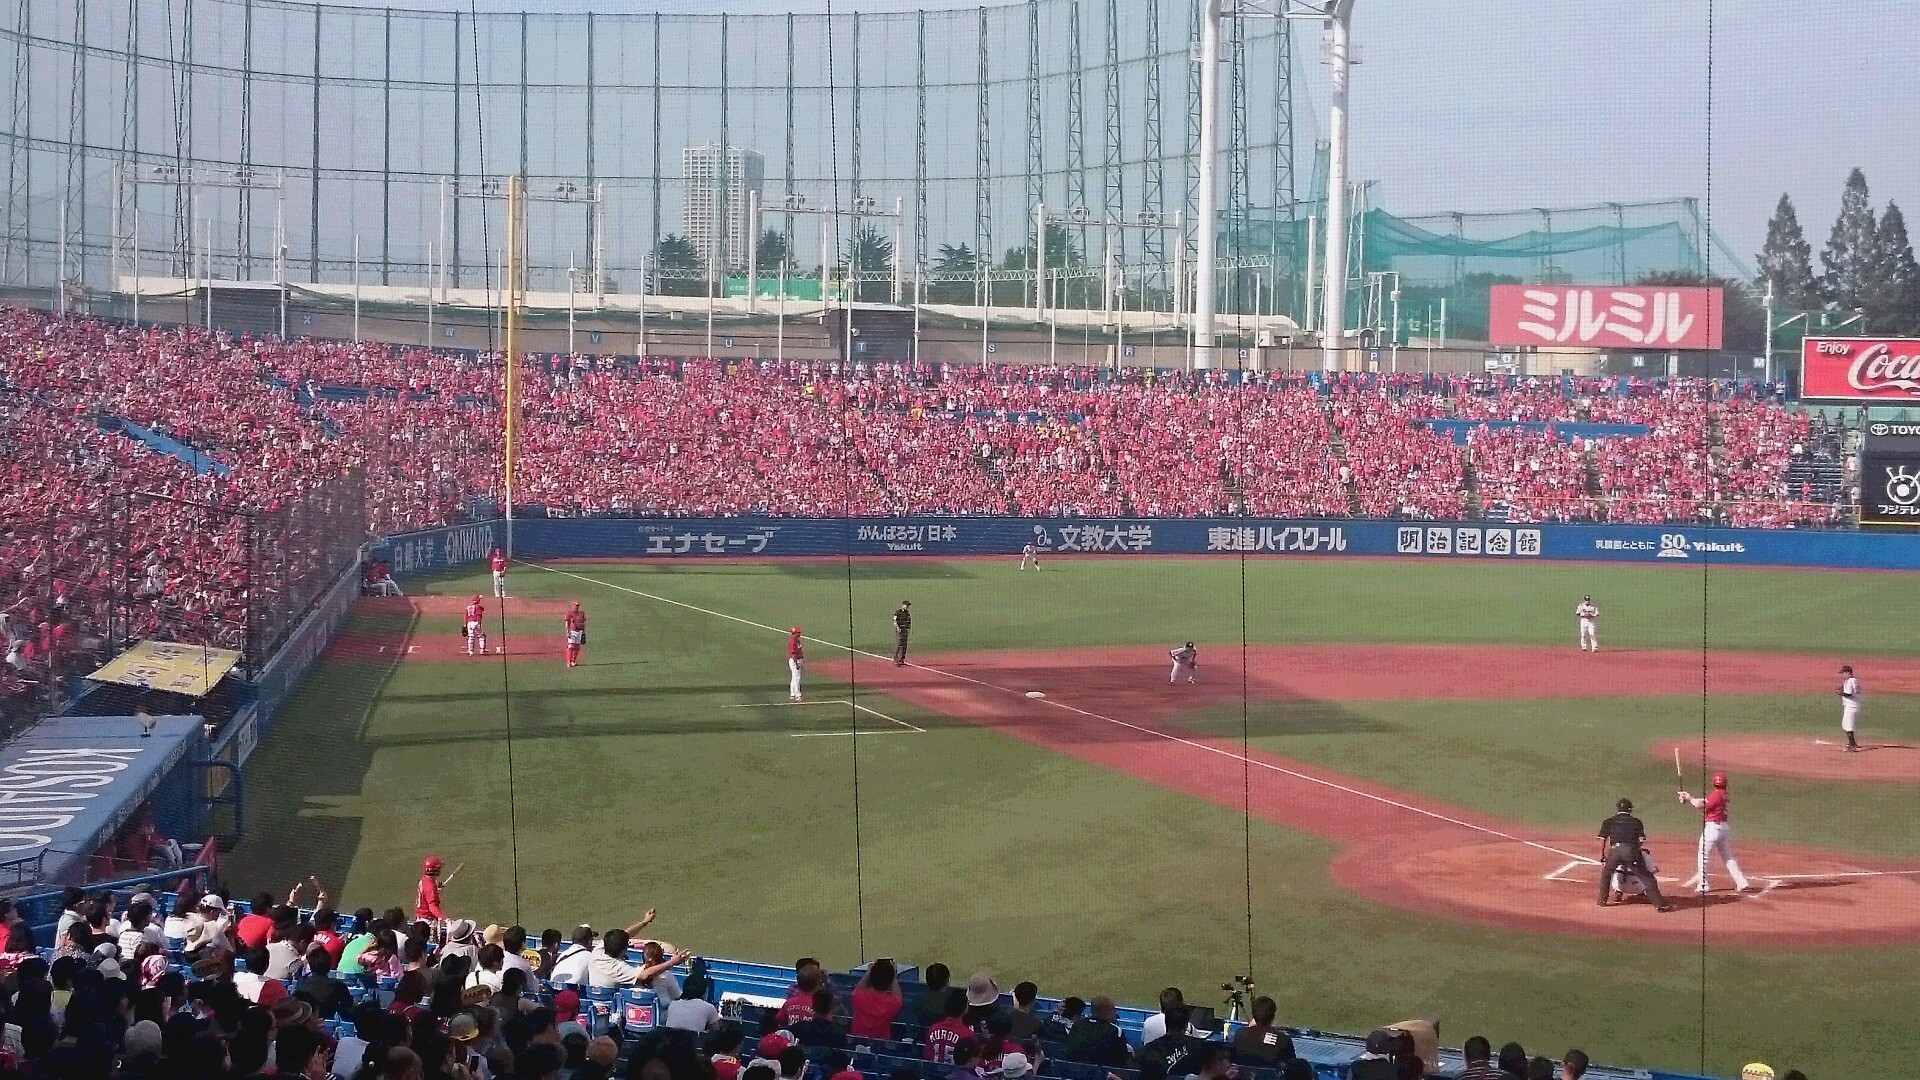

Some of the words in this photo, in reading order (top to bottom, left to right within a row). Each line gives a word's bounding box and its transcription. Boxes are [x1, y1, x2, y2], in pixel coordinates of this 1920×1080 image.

[1518, 290, 1694, 344] ミルミル
[725, 339, 733, 348] U
[858, 342, 865, 351] T
[988, 344, 996, 353] S
[1816, 342, 1851, 355] Enjoy
[1125, 347, 1133, 356] R
[1370, 352, 1378, 361] P
[1633, 357, 1644, 367] N
[1754, 358, 1765, 368] M
[646, 531, 774, 553] エナセーブ
[1057, 524, 1152, 551] 文教大学
[1207, 526, 1347, 551] 東進ハイスクール
[1400, 530, 1538, 552] 明治記念館
[445, 525, 494, 566] ONWARD
[886, 542, 924, 551] Yakult
[1692, 541, 1746, 553] Yakult
